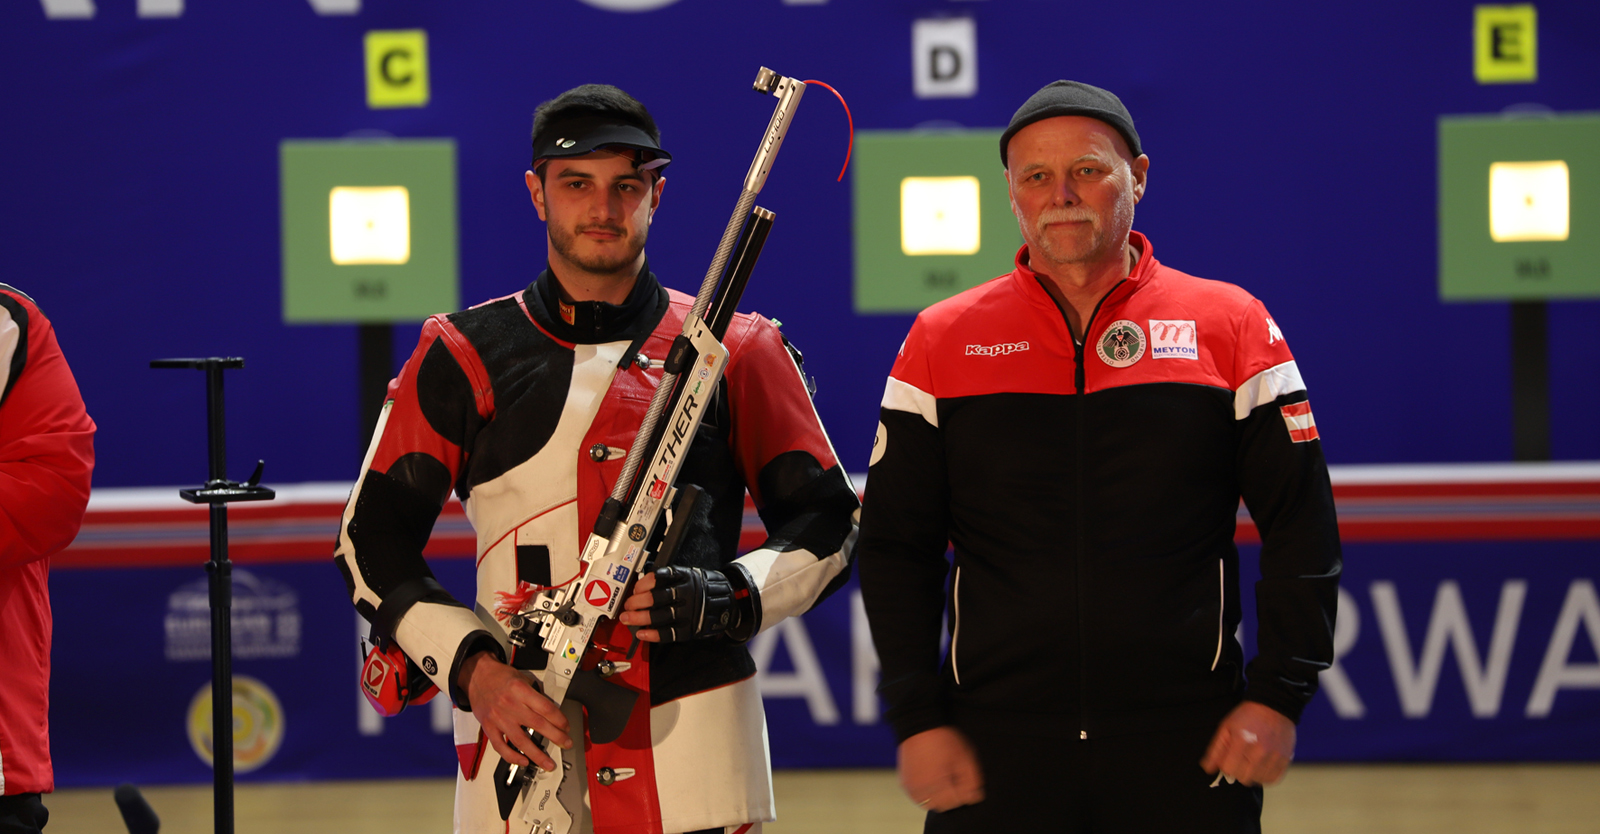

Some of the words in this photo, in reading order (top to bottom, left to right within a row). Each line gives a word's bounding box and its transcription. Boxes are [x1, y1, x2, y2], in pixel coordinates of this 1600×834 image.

[1491, 22, 1523, 62] E
[380, 48, 412, 88] C
[929, 46, 962, 82] D
[764, 109, 785, 154] LG400
[965, 341, 1030, 357] Kappa
[1153, 346, 1196, 354] MEYTON
